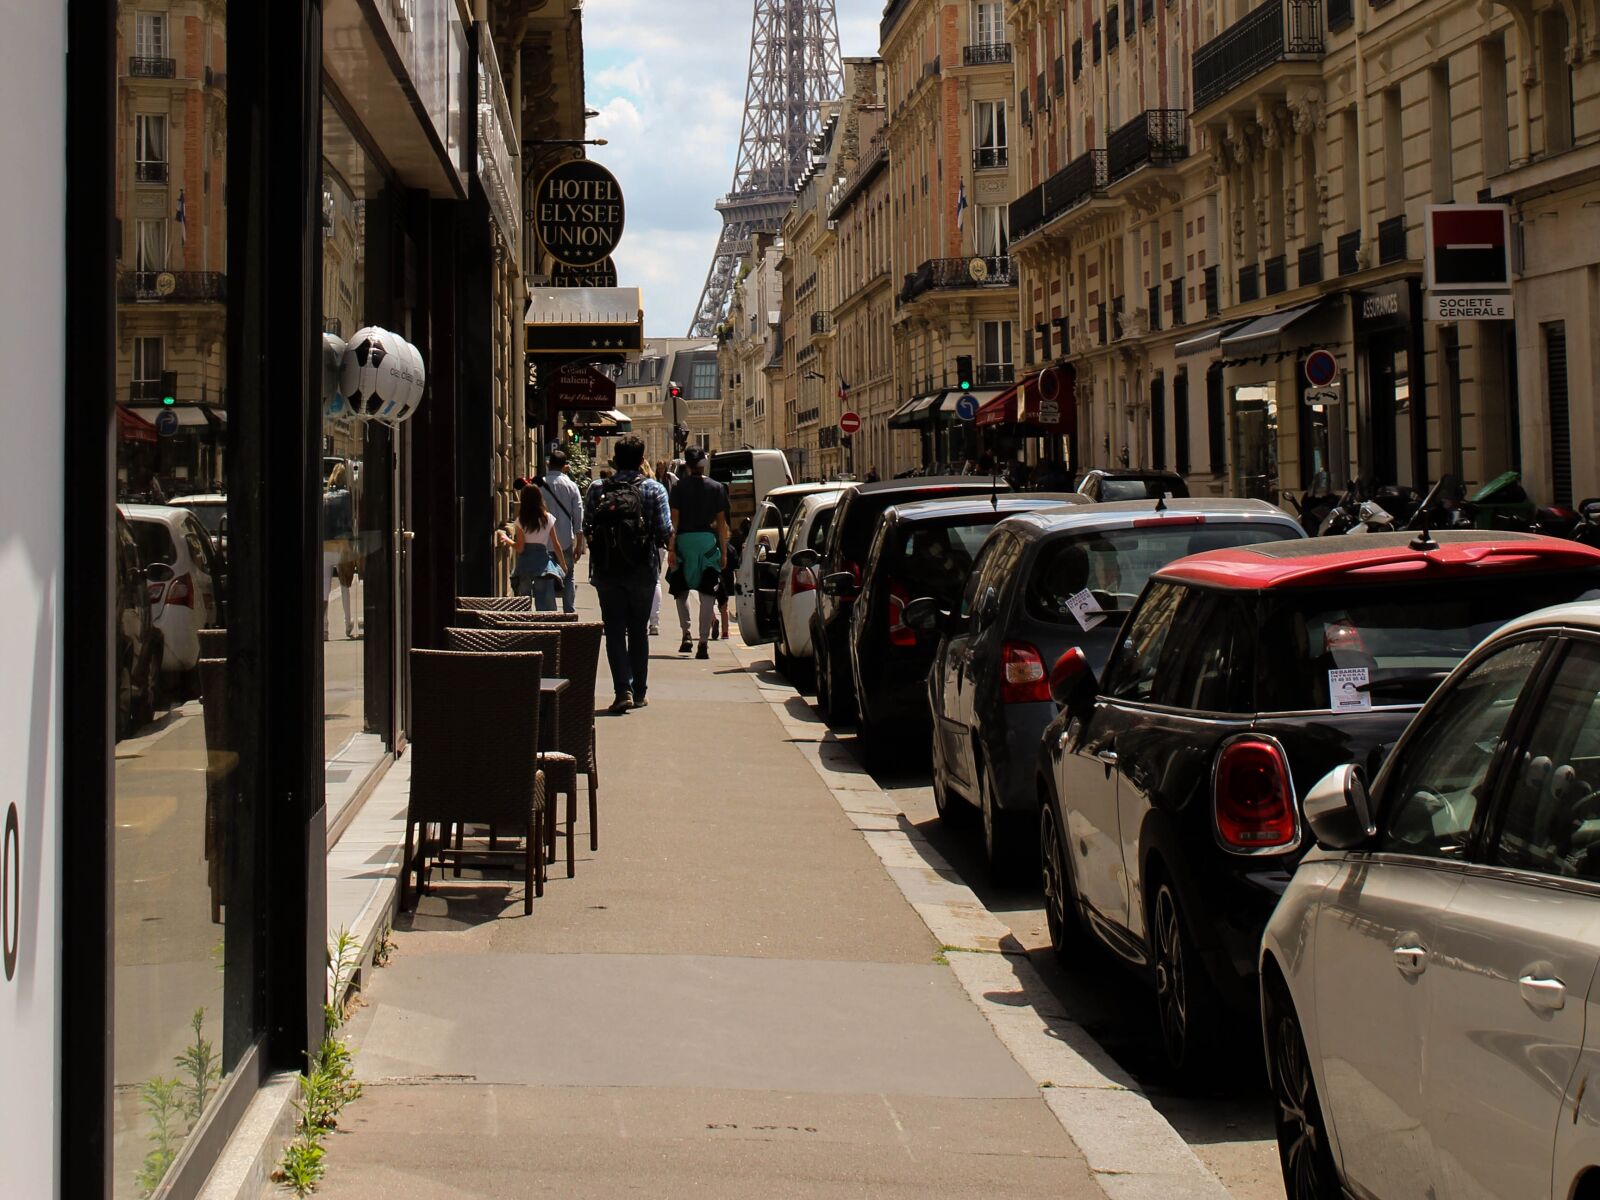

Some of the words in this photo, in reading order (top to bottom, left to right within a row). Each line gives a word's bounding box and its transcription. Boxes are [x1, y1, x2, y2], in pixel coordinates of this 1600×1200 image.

[549, 179, 618, 200] HOTEL
[541, 203, 620, 223] ELYSEE
[543, 226, 613, 246] UNION
[1439, 298, 1493, 308] SOCIETE
[1439, 308, 1505, 317] GENERALE
